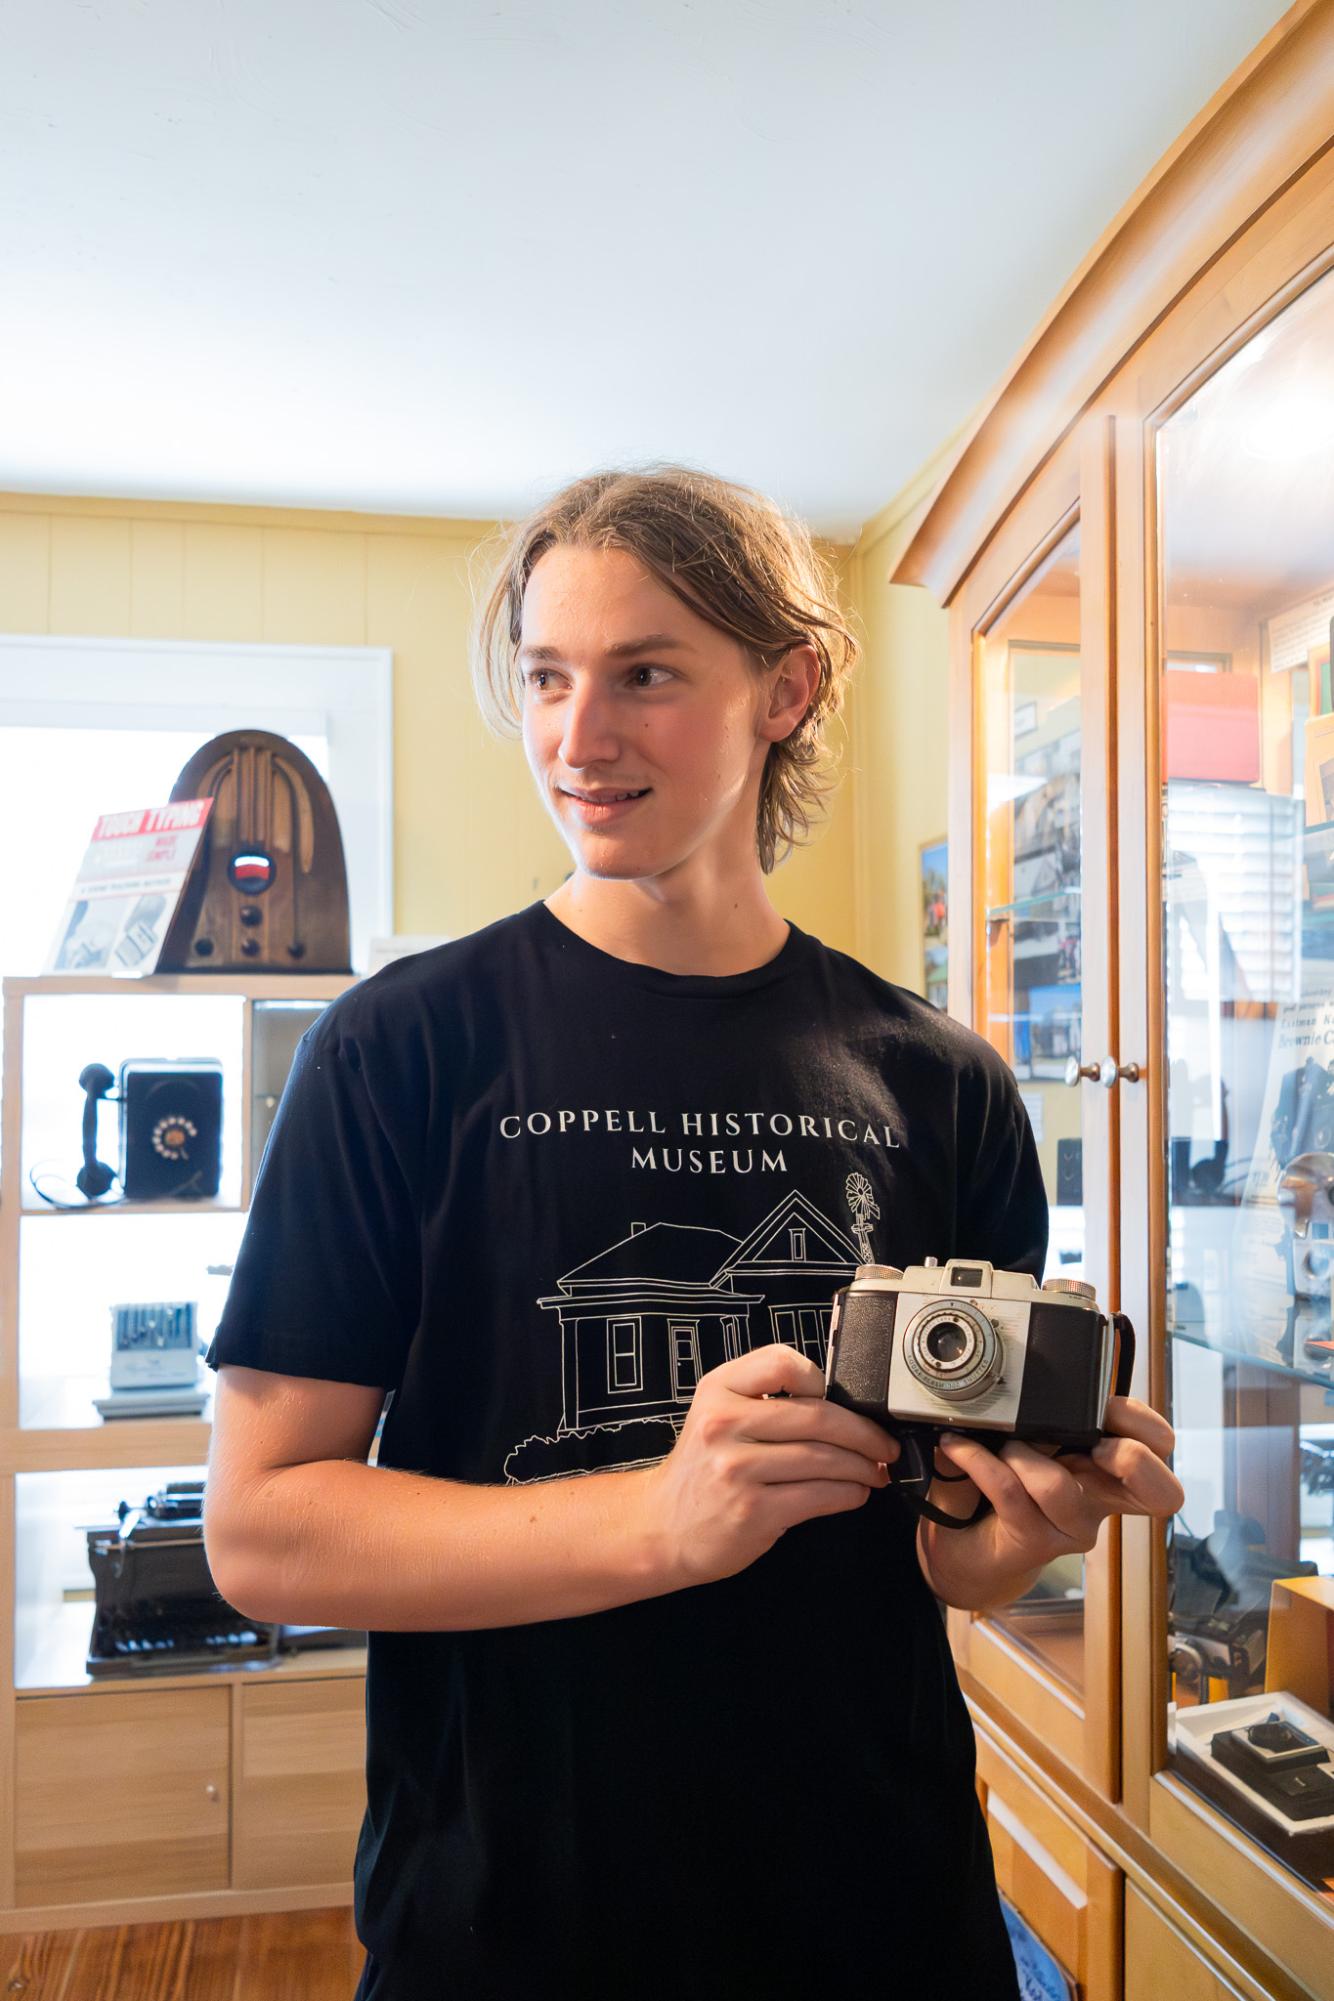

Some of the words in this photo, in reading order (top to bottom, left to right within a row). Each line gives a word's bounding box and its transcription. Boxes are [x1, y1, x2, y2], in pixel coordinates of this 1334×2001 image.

[147, 800, 205, 833] TYPING
[500, 1110, 666, 1139] COPPELL
[682, 1113, 901, 1149] HISTORICAL
[631, 1147, 787, 1174] MUSEUM
